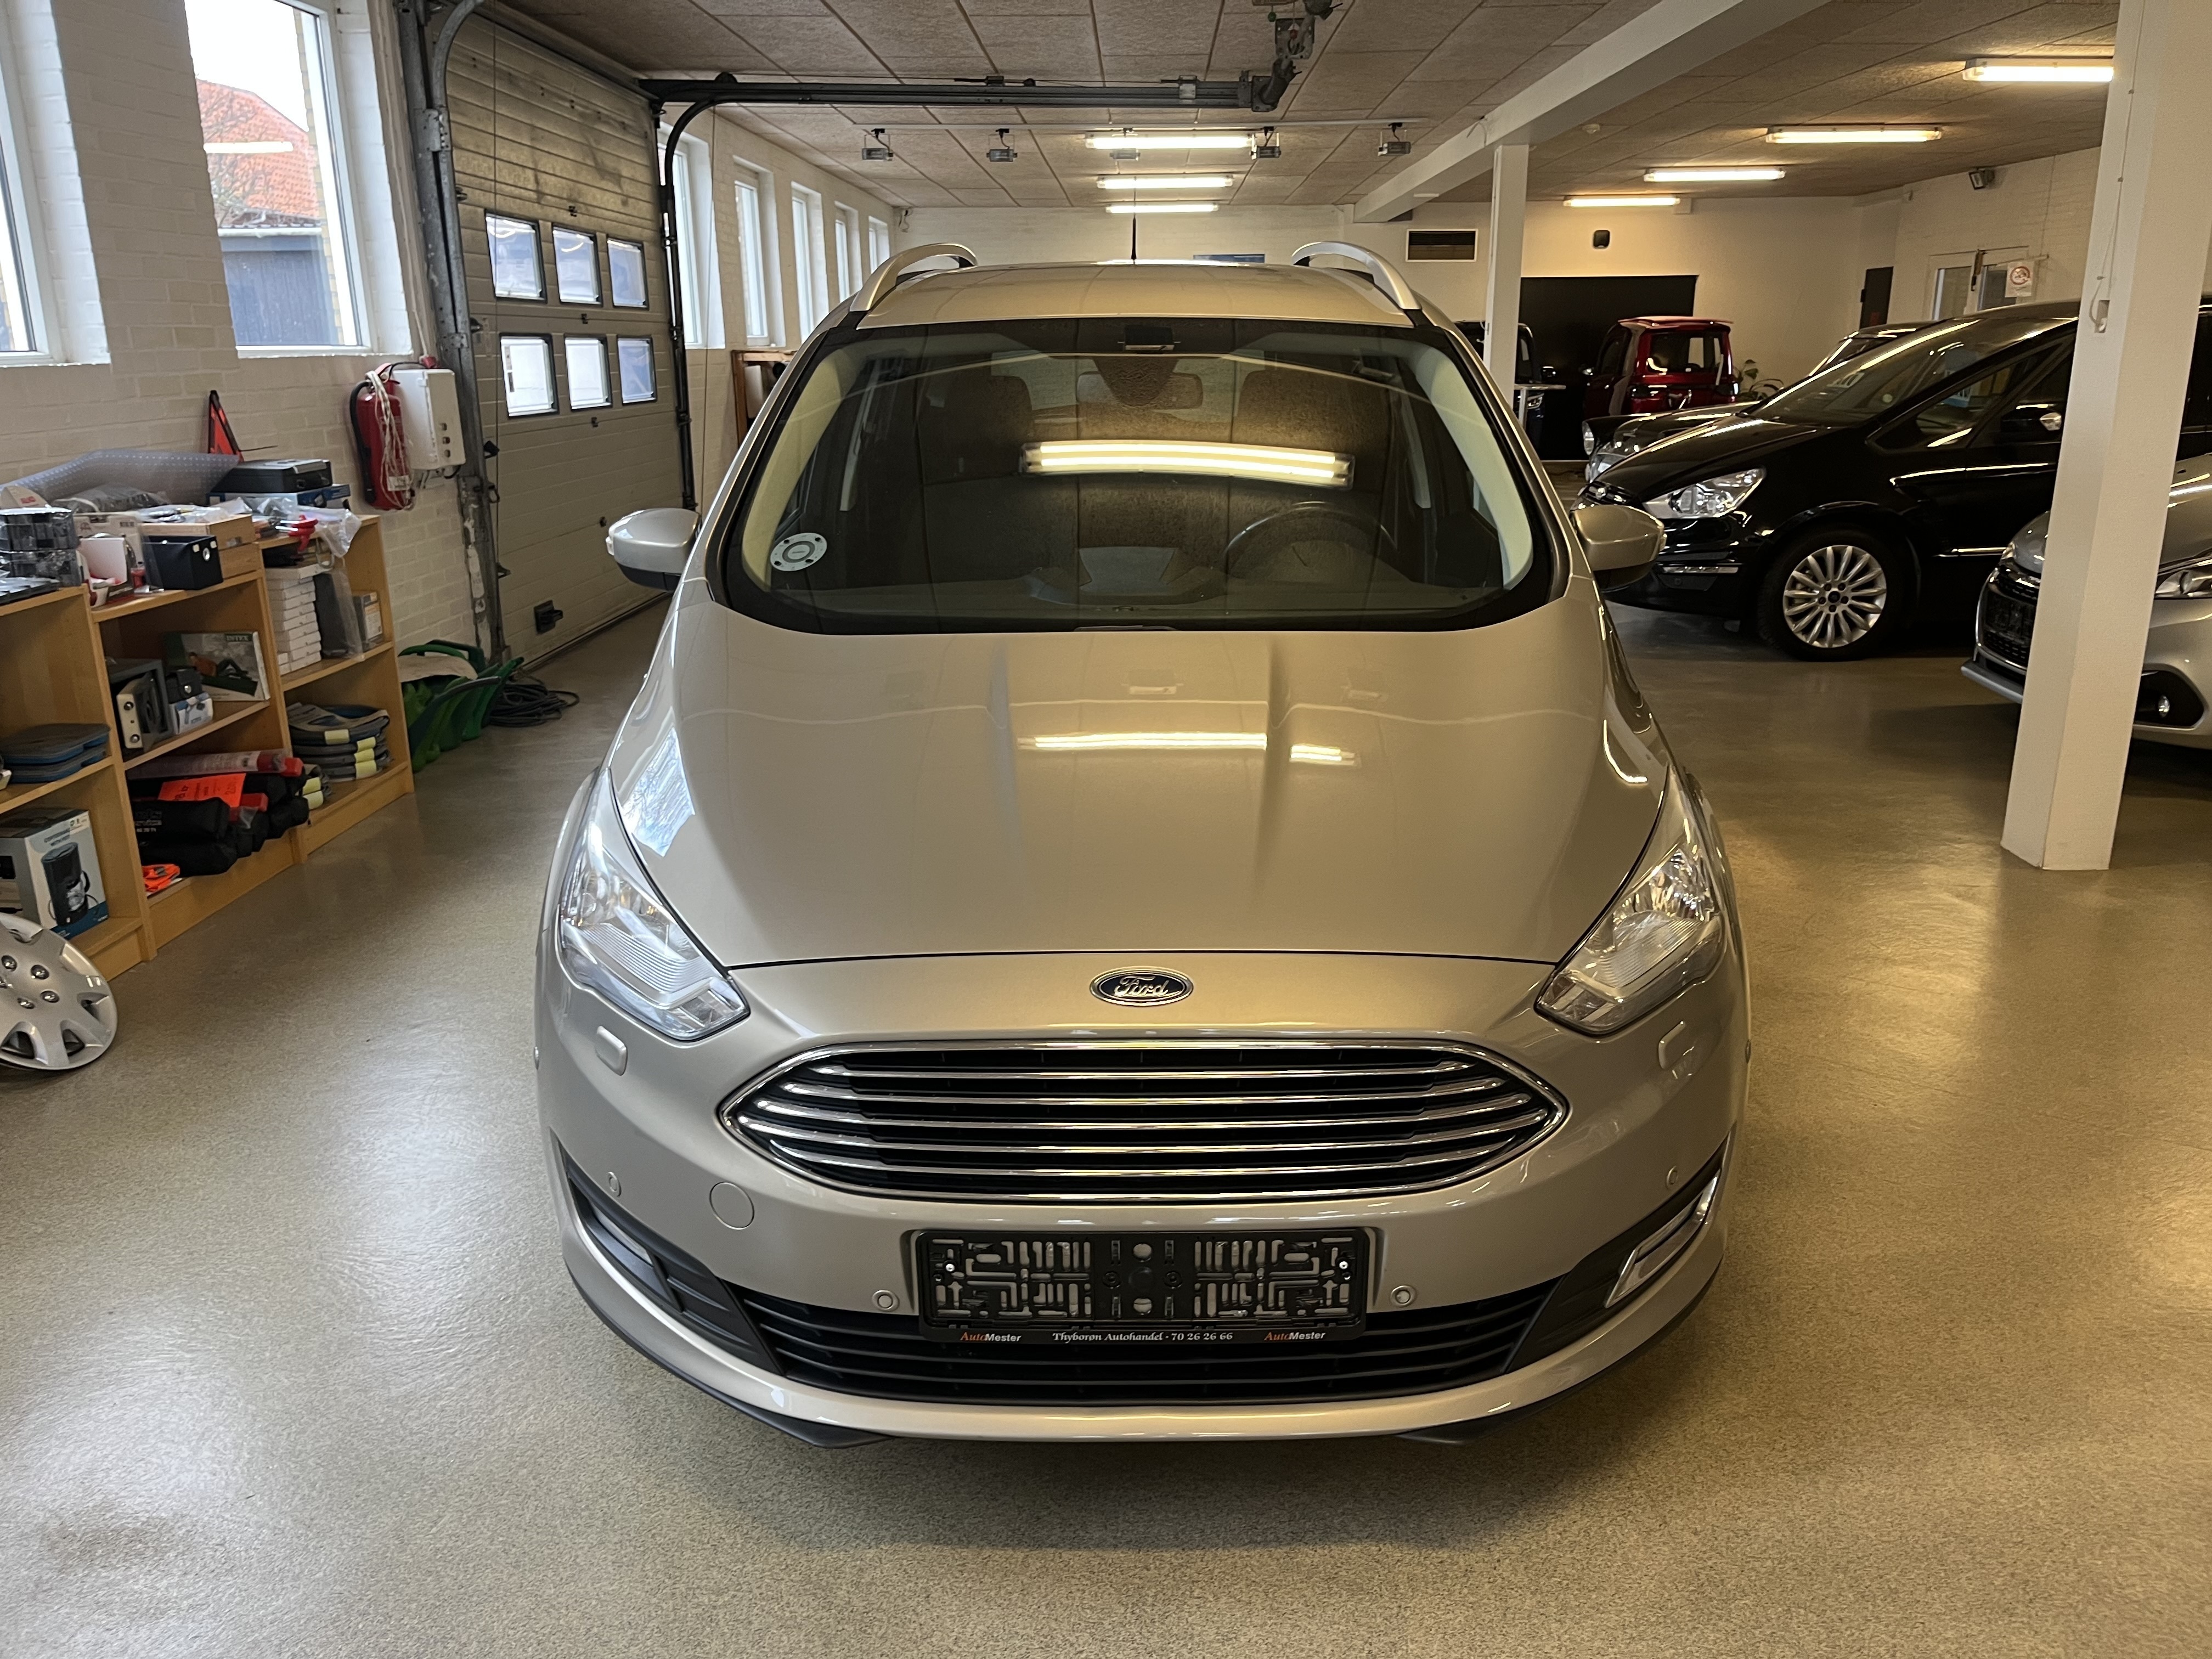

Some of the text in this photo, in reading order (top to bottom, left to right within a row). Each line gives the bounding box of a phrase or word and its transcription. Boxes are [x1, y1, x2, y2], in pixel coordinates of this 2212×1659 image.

[1114, 975, 1169, 997] Ford
[1052, 1331, 1102, 1344] Thyborøn
[1104, 1331, 1163, 1341] Autohandel
[1171, 1333, 1184, 1341] 70
[1187, 1333, 1201, 1341] 26
[1219, 1332, 1233, 1340] 66
